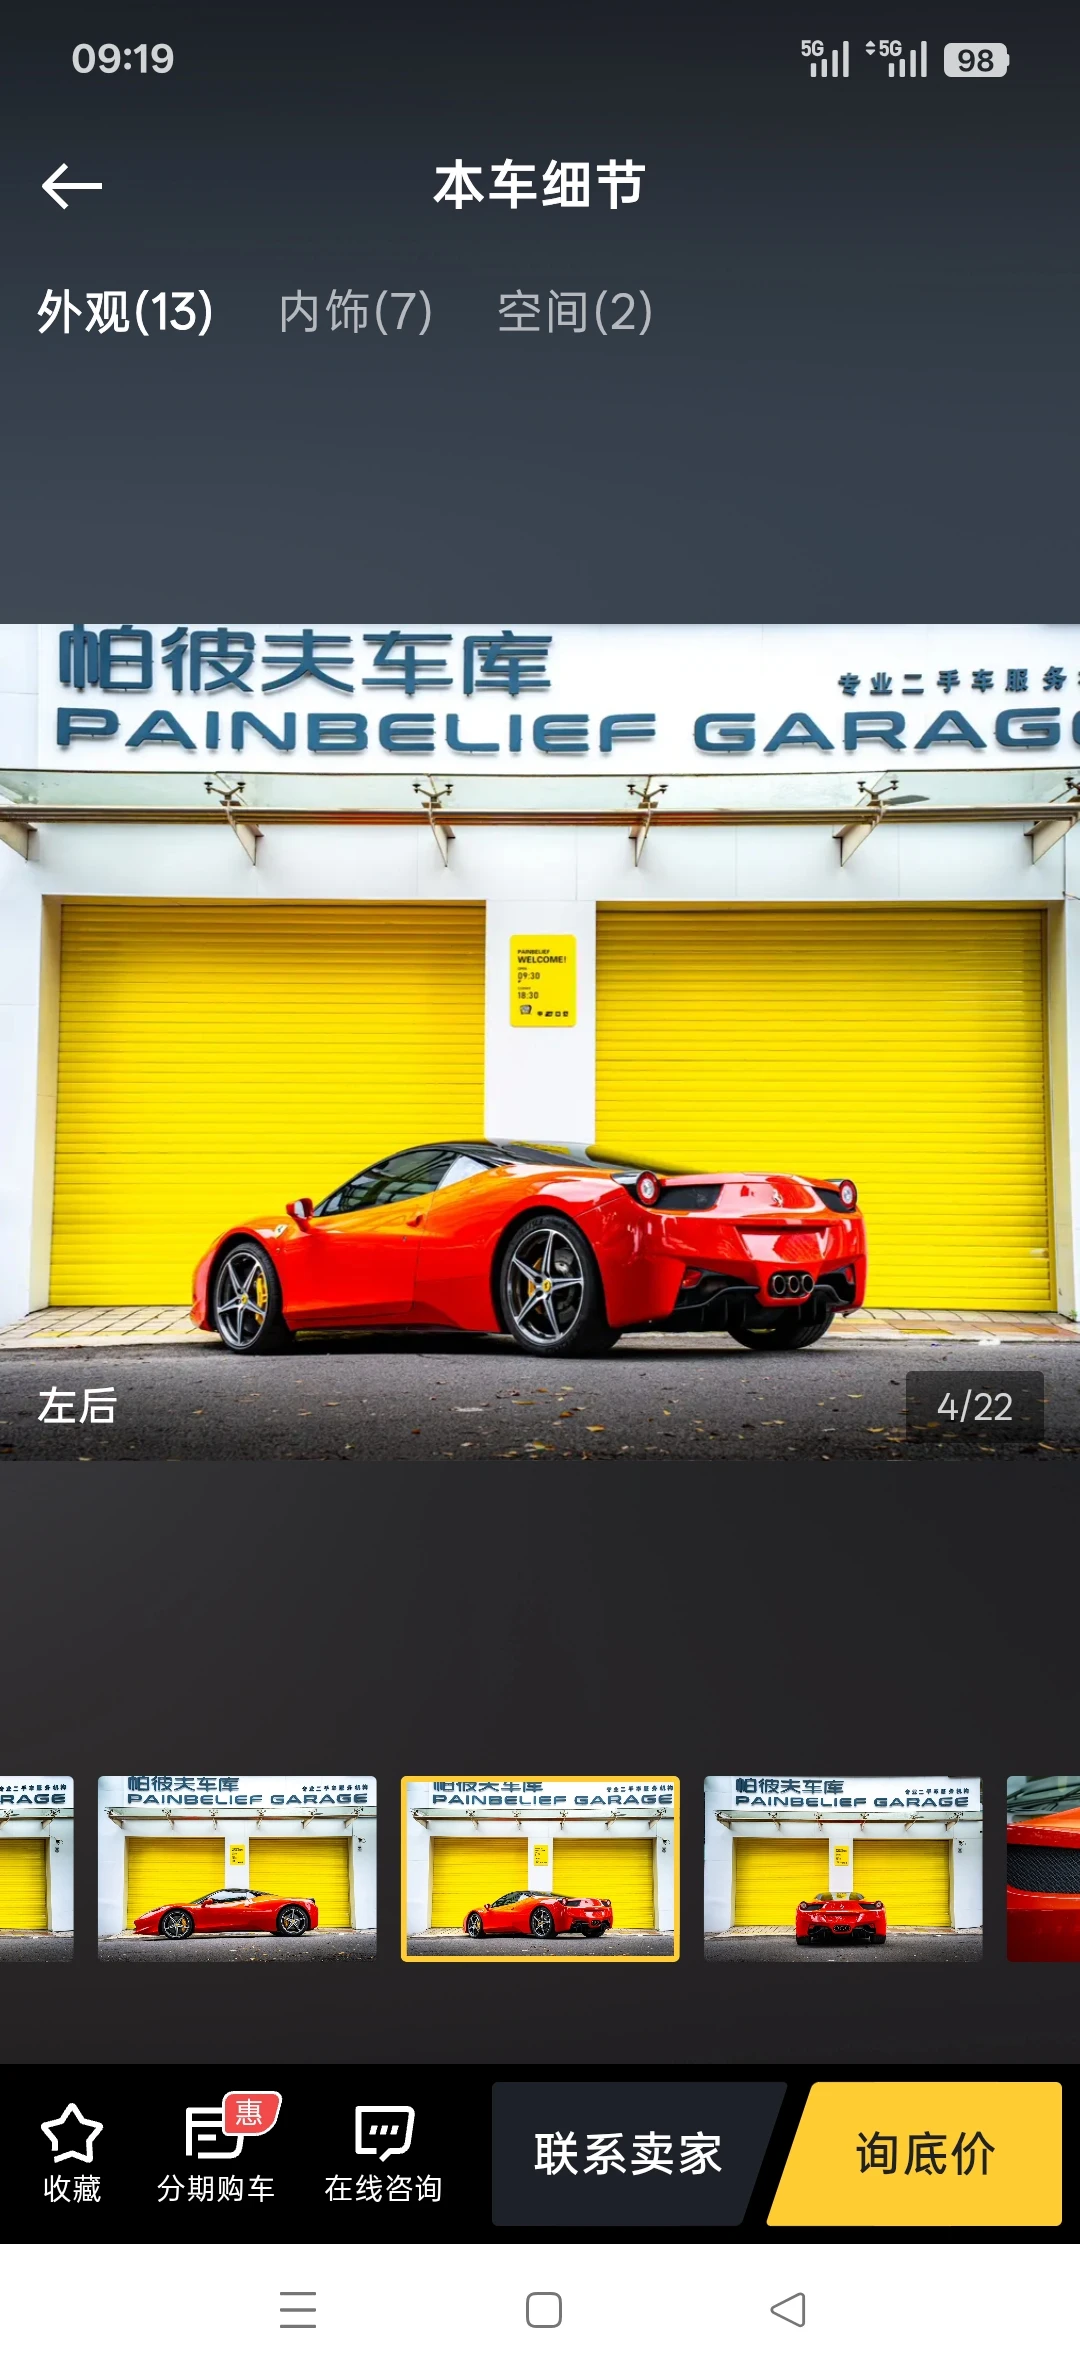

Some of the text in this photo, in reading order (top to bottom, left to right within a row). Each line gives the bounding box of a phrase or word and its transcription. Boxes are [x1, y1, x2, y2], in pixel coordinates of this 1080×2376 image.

[72, 43, 174, 74] 09:19
[801, 39, 825, 57] 5G
[879, 39, 903, 57] 5G
[957, 48, 995, 73] 98
[433, 158, 646, 210] 本车细节
[37, 288, 212, 337] 外观(13)
[280, 288, 432, 336] 内饰(7)
[498, 288, 653, 336] 空间(2)
[59, 624, 553, 695] 帕彼夫车库
[838, 666, 1080, 696] 专业二手车服务
[57, 707, 1080, 755] PAINBELIEF GARAG
[37, 1385, 118, 1424] 左后
[937, 1388, 1013, 1424] 4/22
[127, 1793, 367, 1805] PAINBELIEF GARAGE
[432, 1794, 673, 1806] PAINBELIEF GARAGE
[736, 1796, 969, 1807] PAINBELIEF GARAGE
[235, 2098, 263, 2126] 惠
[534, 2130, 723, 2176] 联系卖家
[856, 2130, 996, 2176] 询底价
[43, 2174, 102, 2204] 收藏
[157, 2174, 275, 2203] 分期购车
[324, 2173, 442, 2203] 在线咨询
